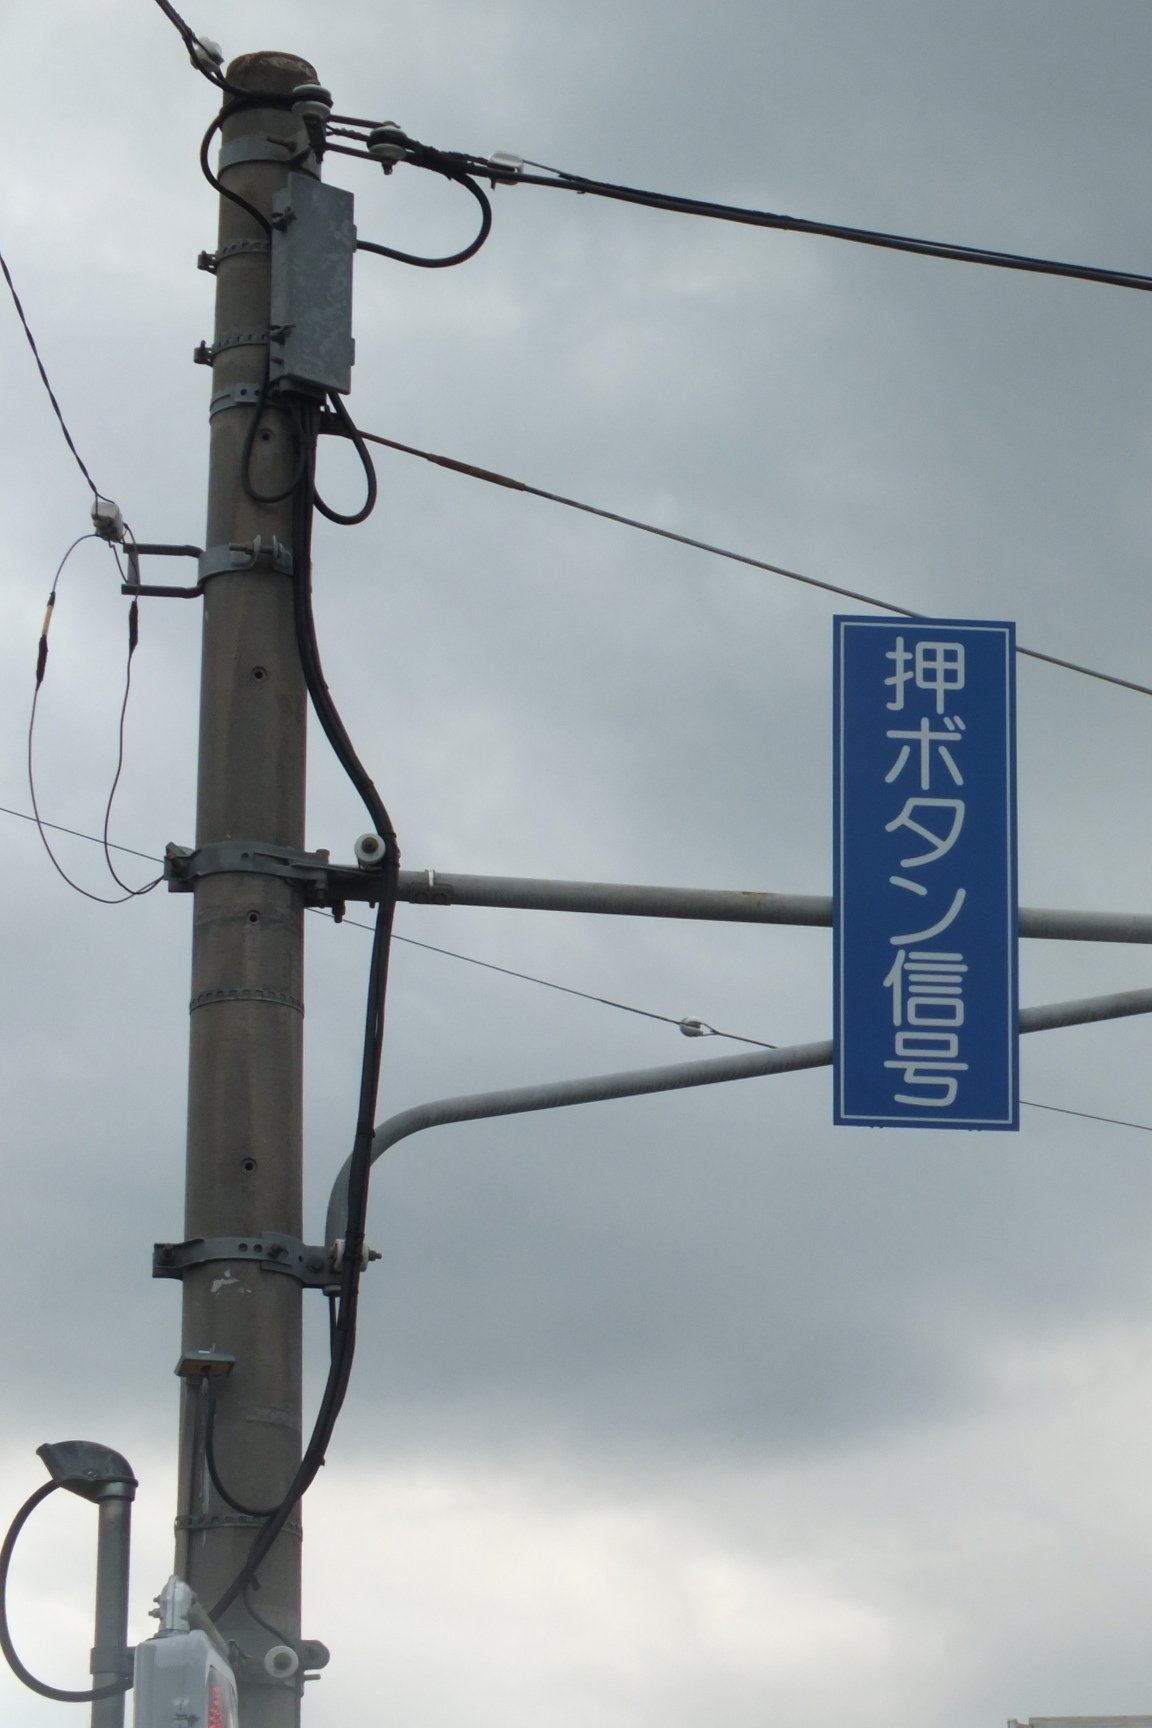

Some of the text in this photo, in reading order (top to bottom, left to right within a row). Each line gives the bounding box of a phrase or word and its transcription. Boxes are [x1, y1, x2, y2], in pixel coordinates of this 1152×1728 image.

[882, 636, 969, 1106] 押ボタン信号
